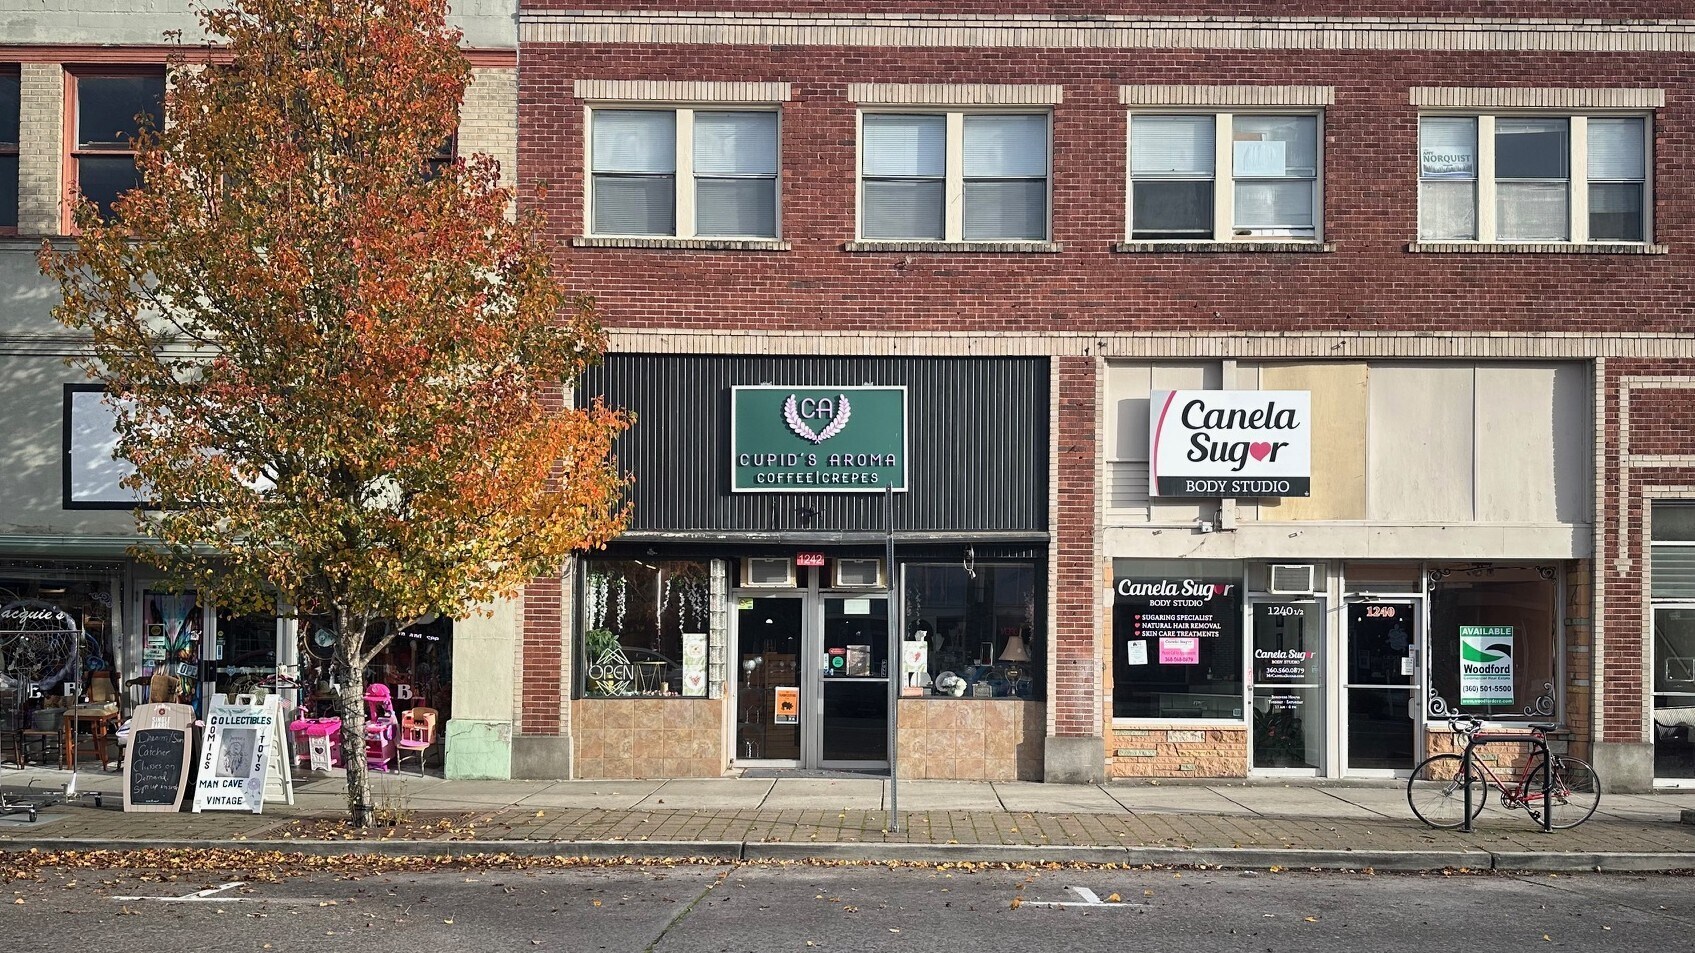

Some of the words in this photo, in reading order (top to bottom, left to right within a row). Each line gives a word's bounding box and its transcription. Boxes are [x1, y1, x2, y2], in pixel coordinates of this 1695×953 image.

[1423, 154, 1471, 163] NORQUIST
[801, 397, 833, 419] CA
[1181, 399, 1301, 430] Canela
[739, 453, 817, 466] CUPID'S
[829, 453, 896, 466] AROMA
[1185, 480, 1227, 493] BODY
[1231, 480, 1290, 493] STUDIO
[798, 554, 823, 565] 1242
[1118, 578, 1180, 596] Canela
[0, 606, 66, 624] acquie's
[1267, 606, 1293, 616] 1240
[1366, 606, 1396, 617] 1240
[1462, 627, 1511, 635] AVAILABLE
[1254, 648, 1288, 659] Canela
[588, 664, 634, 680] OPEN
[1463, 664, 1510, 674] Woodford
[1463, 685, 1479, 693] (360)
[211, 716, 272, 725] COLLECTIBLES
[255, 736, 265, 772] TOYS
[199, 780, 219, 788] MAN
[222, 779, 243, 788] CAVE
[206, 796, 243, 805] VINTAGE
